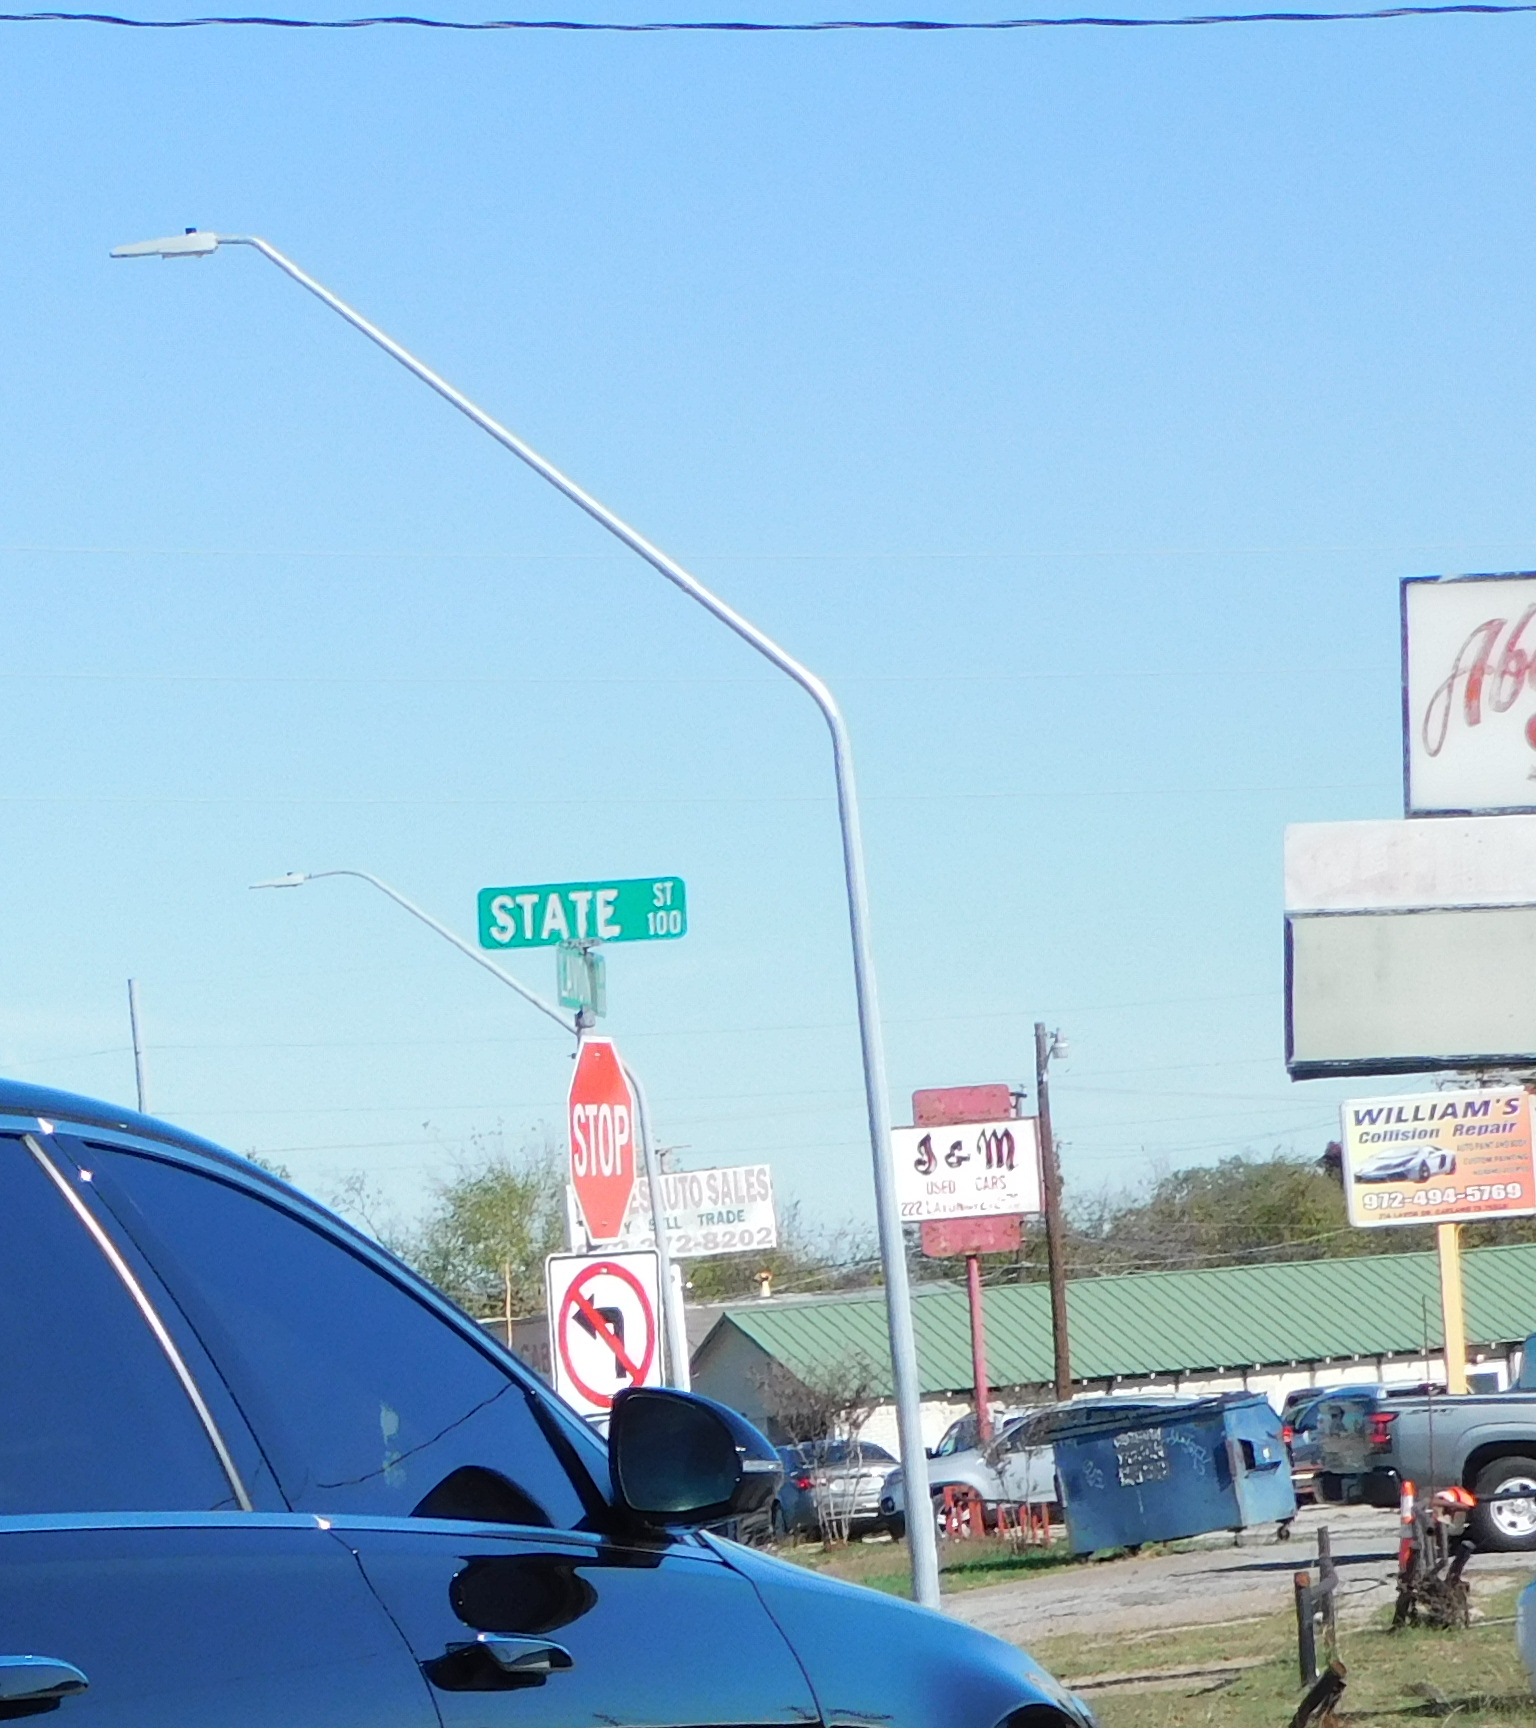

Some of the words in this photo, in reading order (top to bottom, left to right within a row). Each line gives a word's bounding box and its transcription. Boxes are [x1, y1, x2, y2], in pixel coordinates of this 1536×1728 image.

[489, 889, 622, 944] STATE
[653, 882, 674, 907] ST
[647, 910, 682, 936] 100
[1353, 1097, 1520, 1126] WILLIAM'S
[572, 1103, 630, 1177] STOP
[1358, 1127, 1441, 1145] Collision
[1452, 1121, 1518, 1138] Repair
[976, 1127, 1019, 1171] M
[706, 1167, 770, 1207] SALES
[926, 1180, 956, 1195] USED
[975, 1175, 1006, 1191] CARS
[1362, 1181, 1523, 1210] 972-494-5769
[697, 1209, 746, 1226] TRADE
